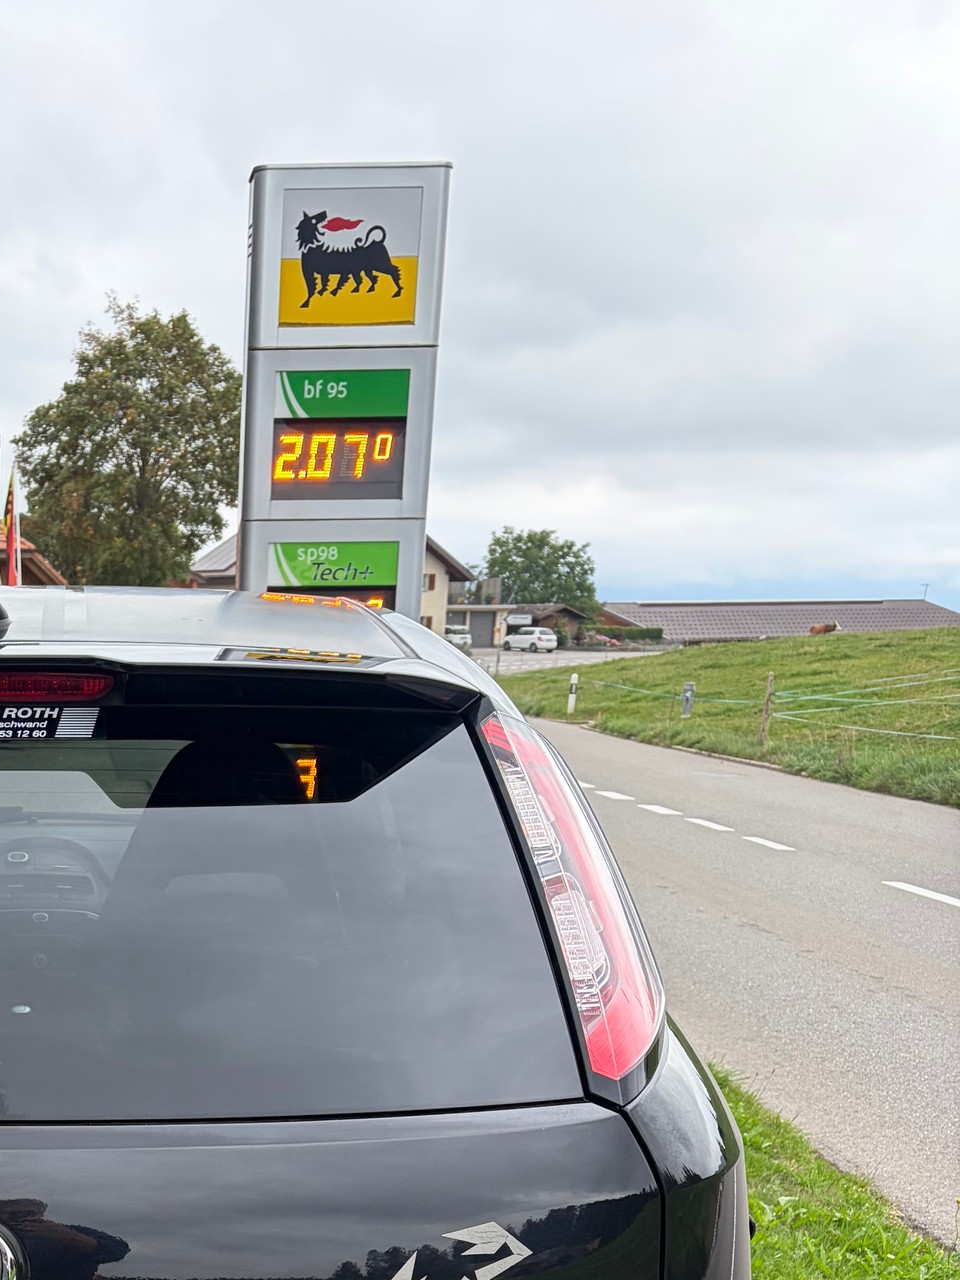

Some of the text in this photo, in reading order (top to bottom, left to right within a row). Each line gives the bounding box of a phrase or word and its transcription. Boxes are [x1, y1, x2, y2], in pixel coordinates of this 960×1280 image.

[303, 379, 348, 399] bf 95
[296, 546, 339, 565] sp98
[311, 562, 374, 582] Tech+
[3, 708, 60, 719] ROTH
[16, 730, 30, 738] 12
[32, 730, 47, 738] 60
